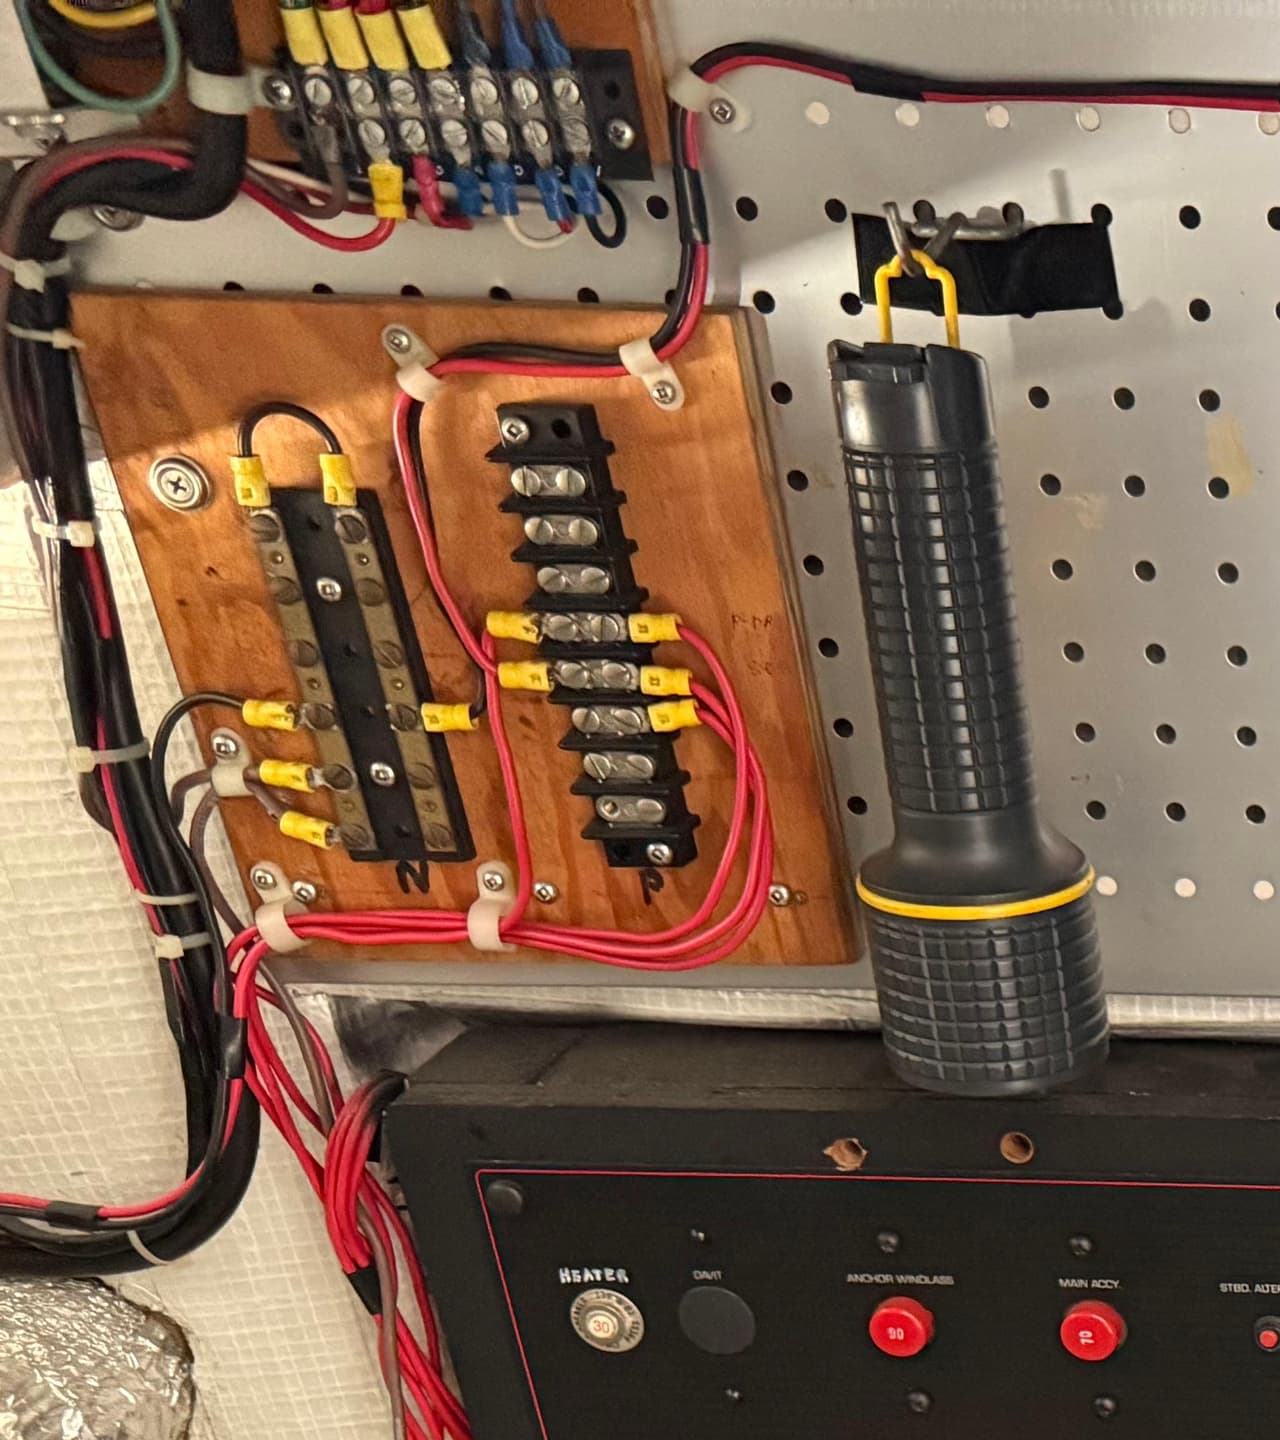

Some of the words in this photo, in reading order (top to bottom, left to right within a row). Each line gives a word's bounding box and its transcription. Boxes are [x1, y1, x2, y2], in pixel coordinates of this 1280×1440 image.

[559, 1267, 629, 1283] HEATER
[847, 1274, 895, 1284] ANCHOR
[897, 1275, 955, 1286] WINDLASS
[1058, 1278, 1089, 1288] MAIN
[592, 1319, 610, 1334] 30
